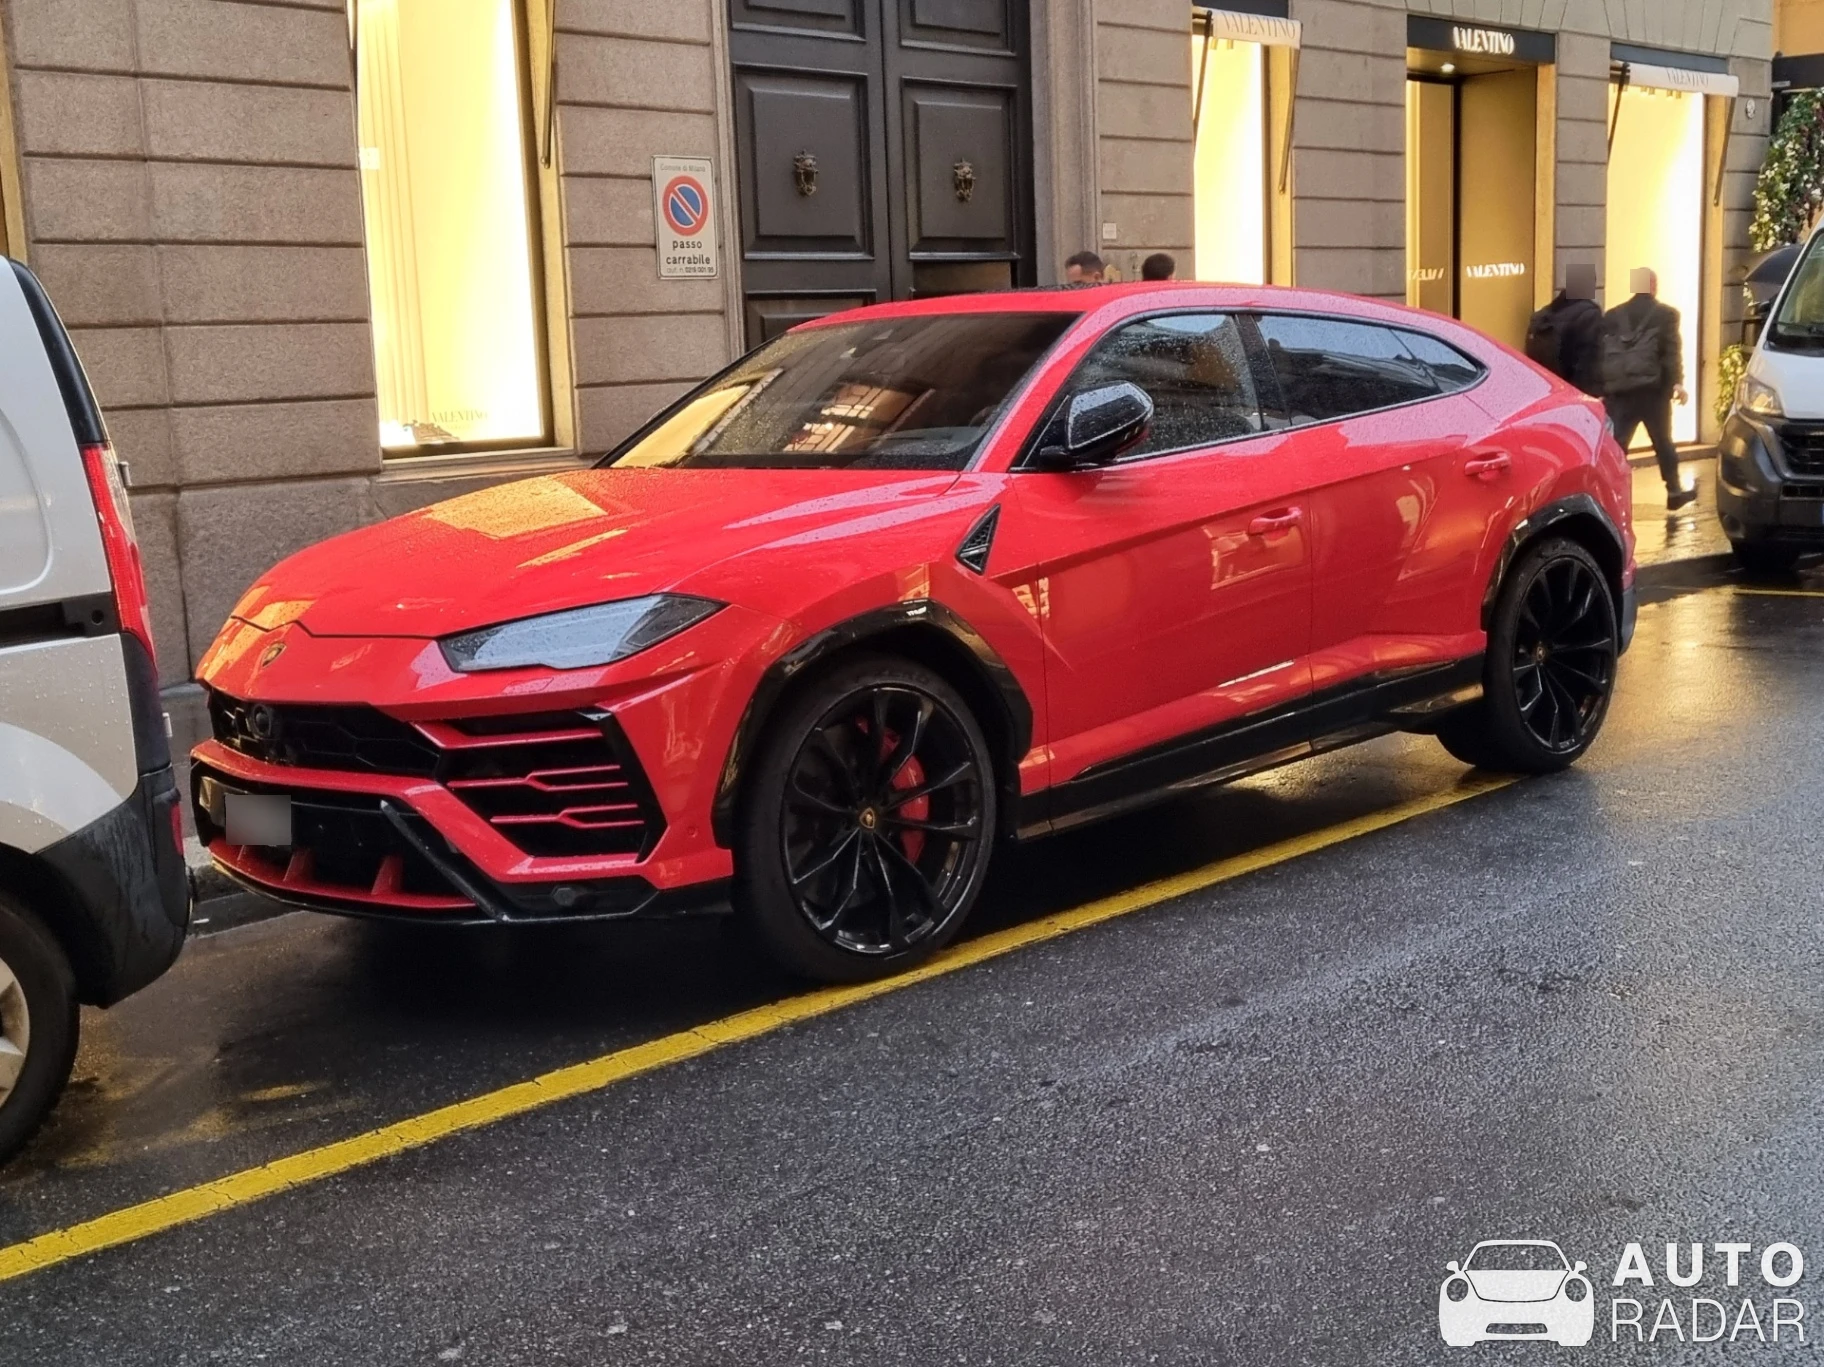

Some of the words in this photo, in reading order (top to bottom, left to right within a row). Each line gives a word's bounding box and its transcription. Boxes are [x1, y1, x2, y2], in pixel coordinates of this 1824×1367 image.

[1221, 12, 1296, 39] VALENTINO
[1453, 26, 1515, 55] VALENTINO
[1665, 67, 1709, 88] VALENTINO
[672, 240, 703, 251] passo
[665, 253, 711, 265] carrabile
[1466, 262, 1525, 278] VALENTINO
